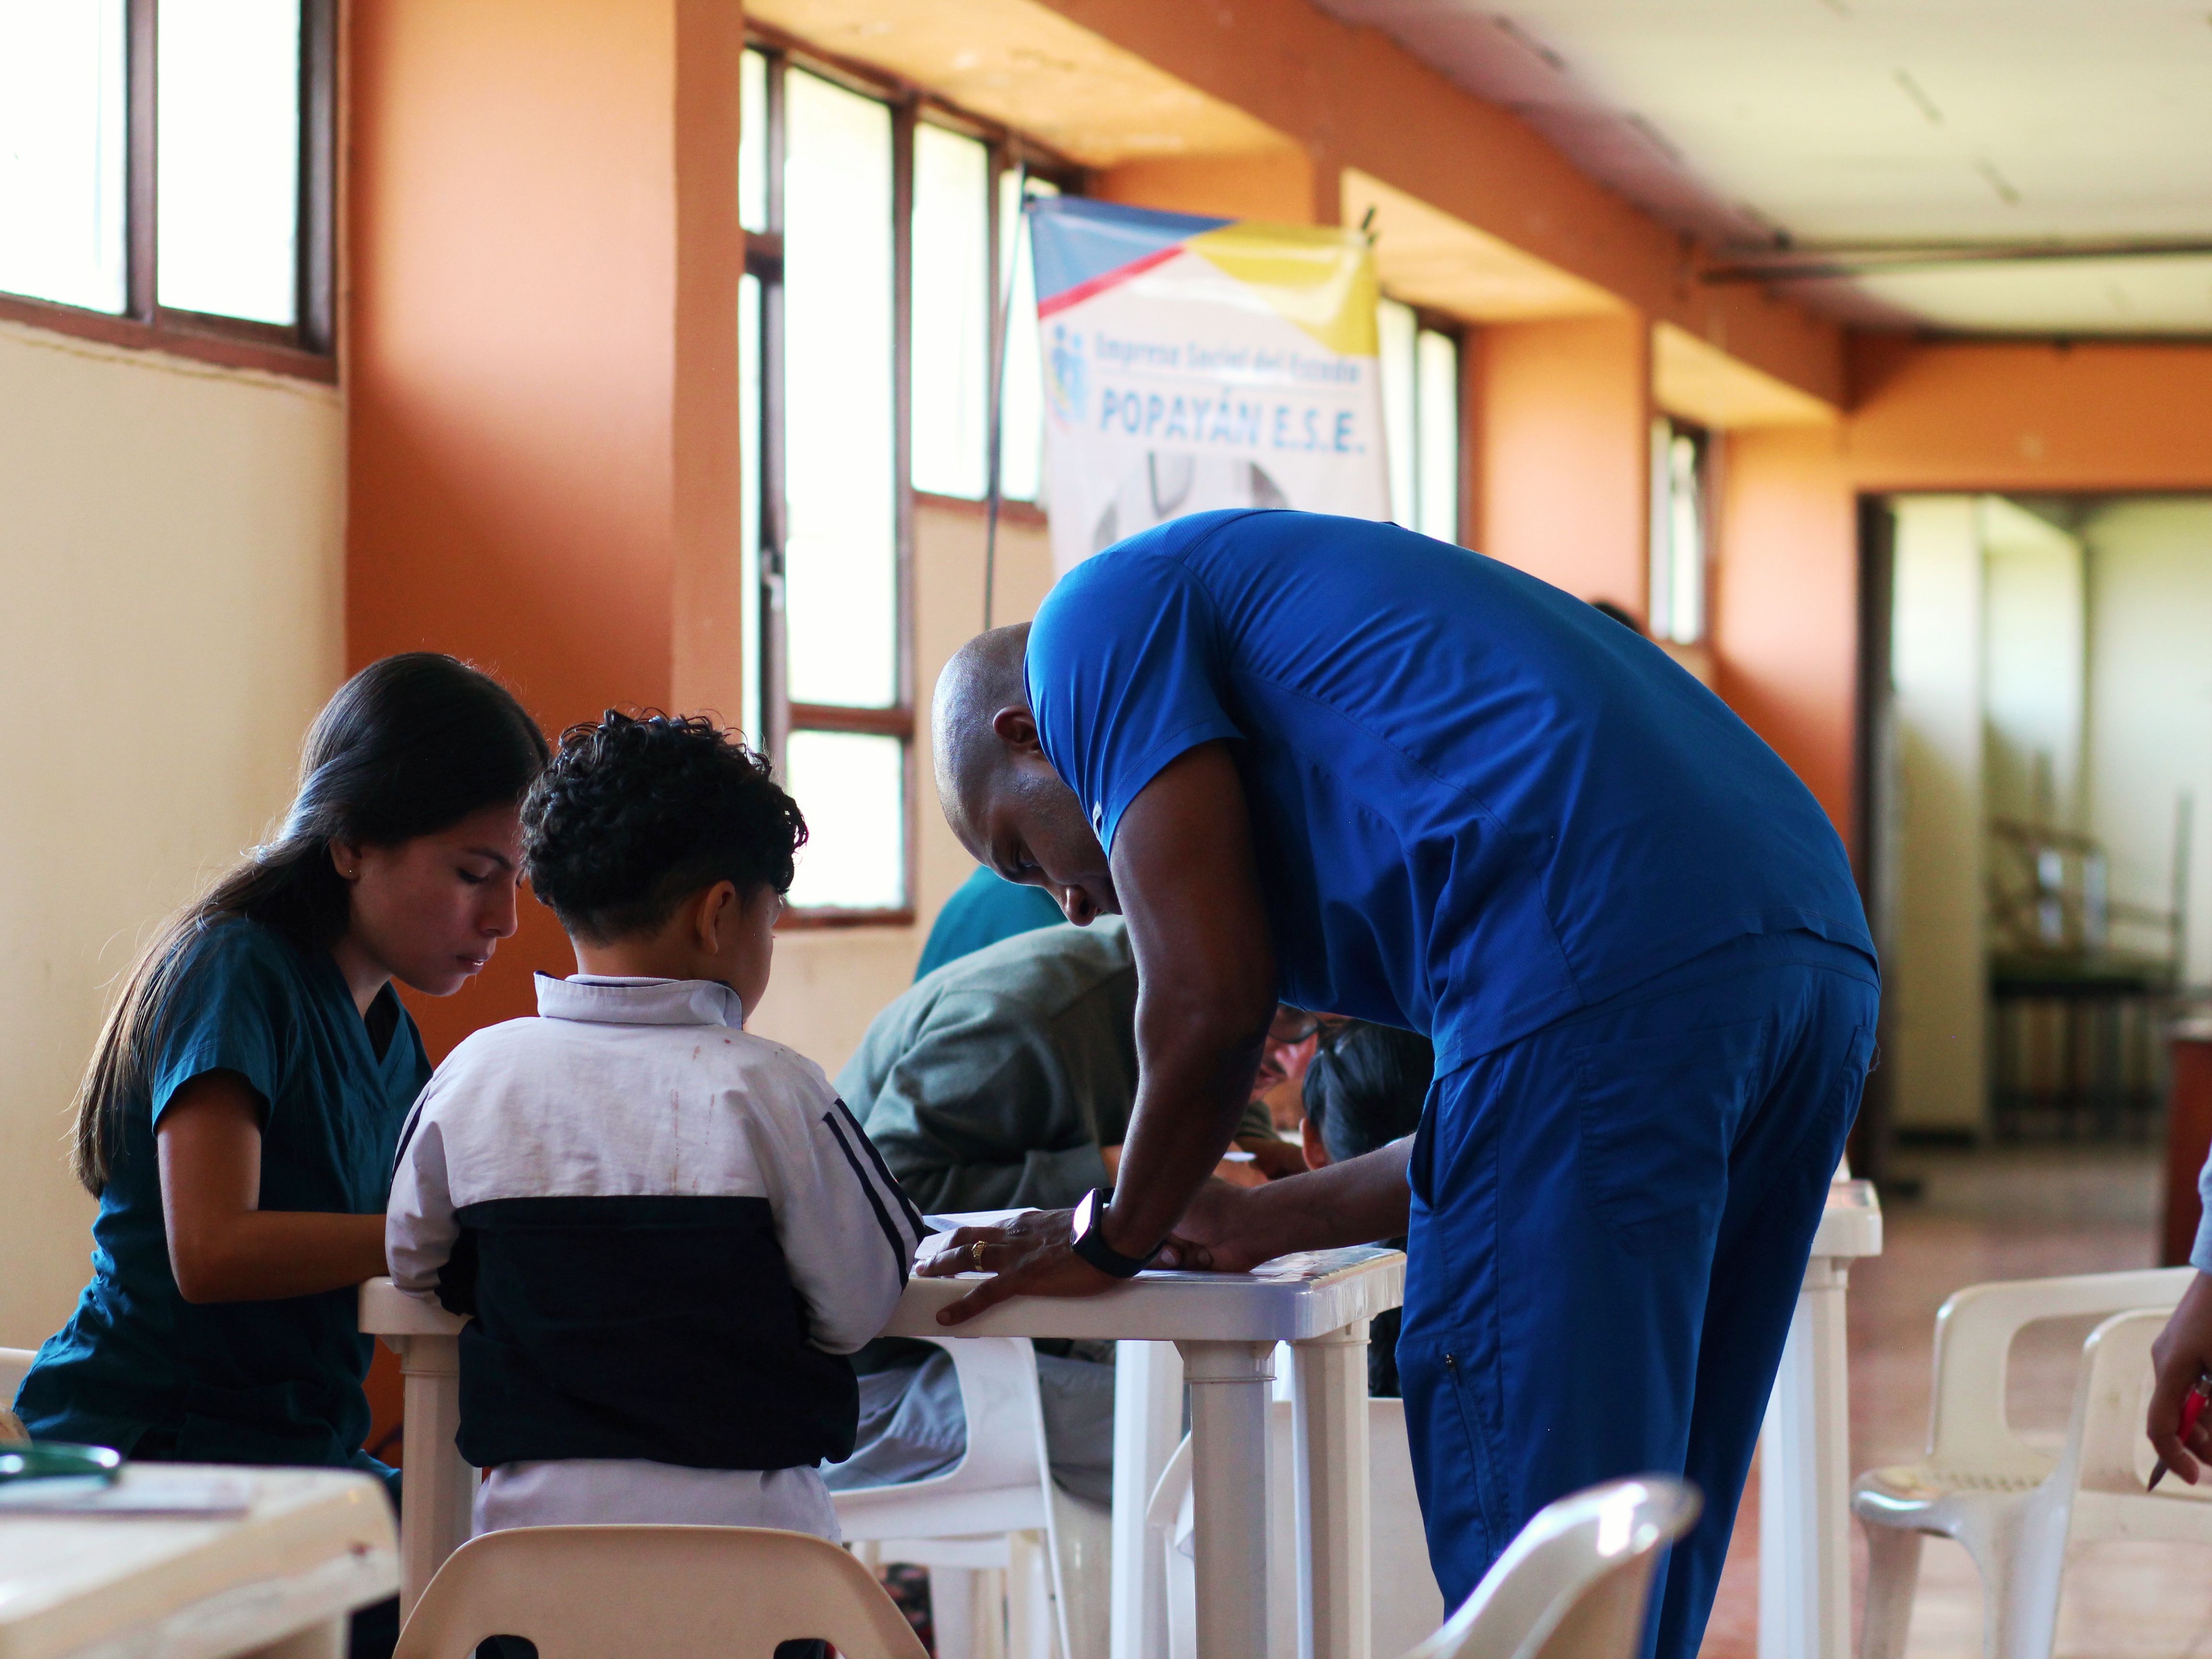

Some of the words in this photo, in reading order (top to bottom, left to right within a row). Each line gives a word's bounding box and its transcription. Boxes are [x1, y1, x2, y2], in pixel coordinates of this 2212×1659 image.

[1095, 332, 1179, 370] Empresa
[1186, 340, 1248, 371] Social
[1253, 347, 1284, 372] del
[1100, 385, 1262, 446] POPAYÁN
[1272, 404, 1366, 455] E.S.E.
